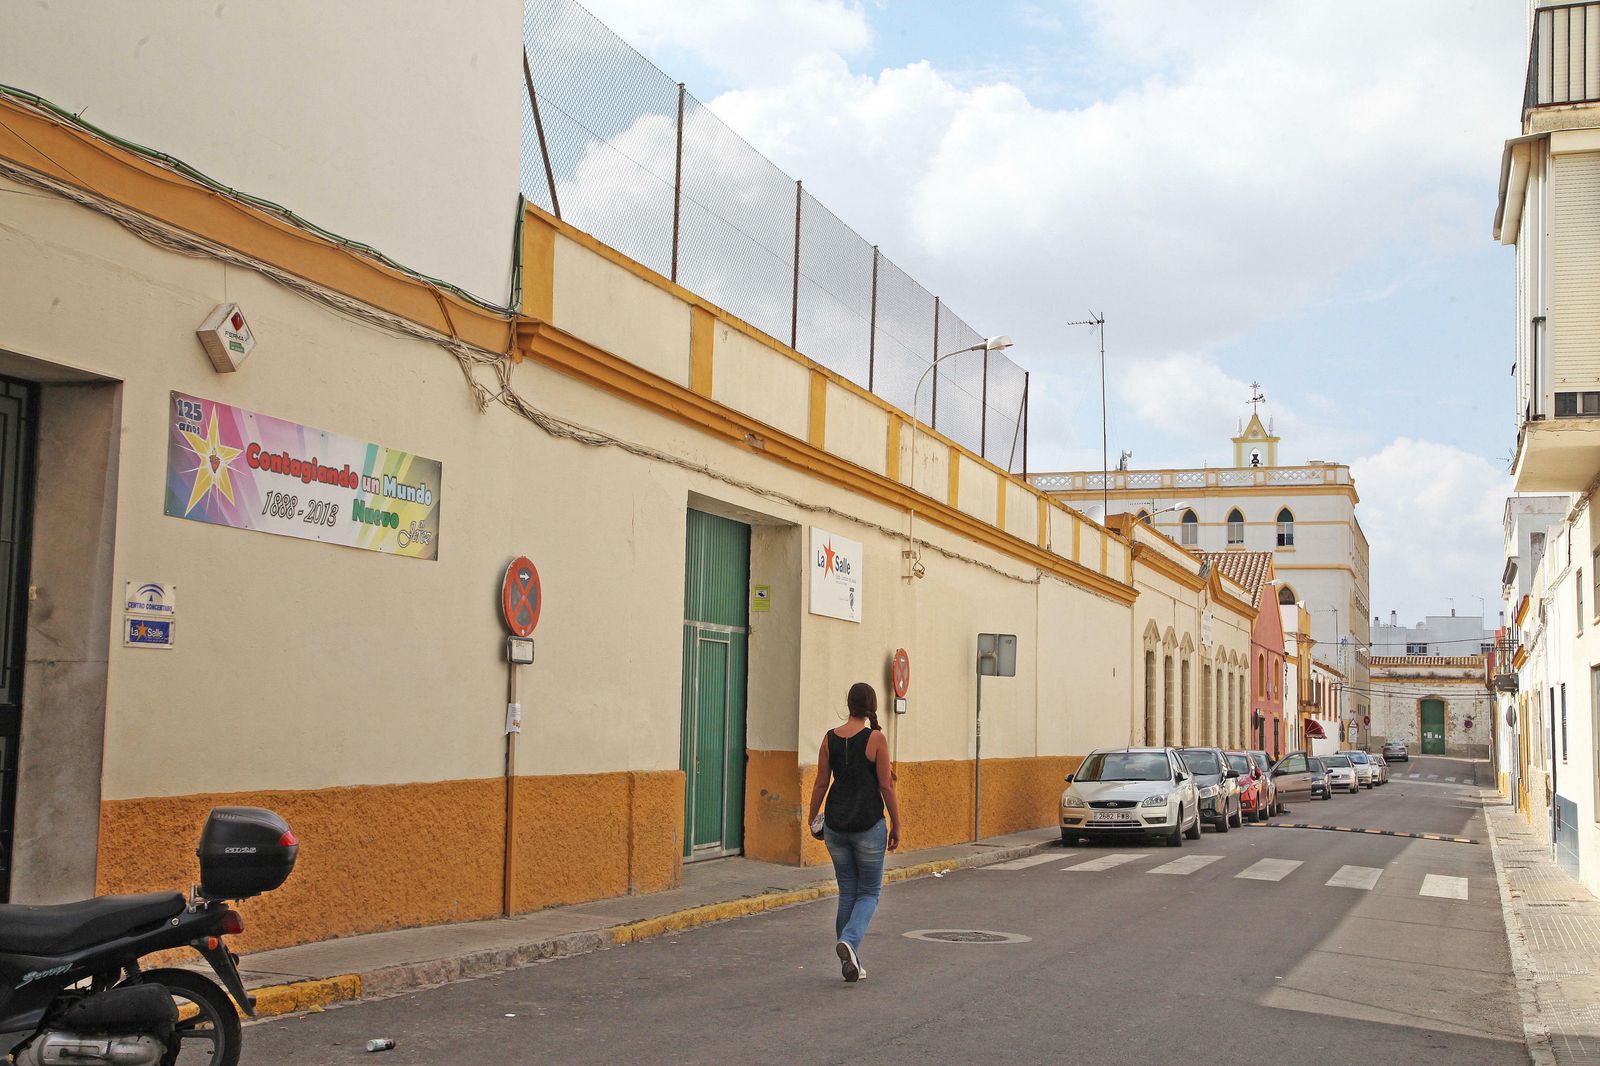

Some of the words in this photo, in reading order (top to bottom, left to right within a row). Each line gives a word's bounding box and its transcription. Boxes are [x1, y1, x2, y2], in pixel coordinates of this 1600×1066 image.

[177, 399, 202, 421] 125
[178, 421, 200, 434] años
[246, 442, 359, 490] Contagiando
[362, 474, 380, 495] un
[383, 474, 432, 506] Mundo
[352, 498, 399, 529] Nuevo
[817, 550, 825, 568] La
[835, 555, 851, 575] Salle
[131, 627, 139, 636] La
[147, 628, 163, 637] Salle
